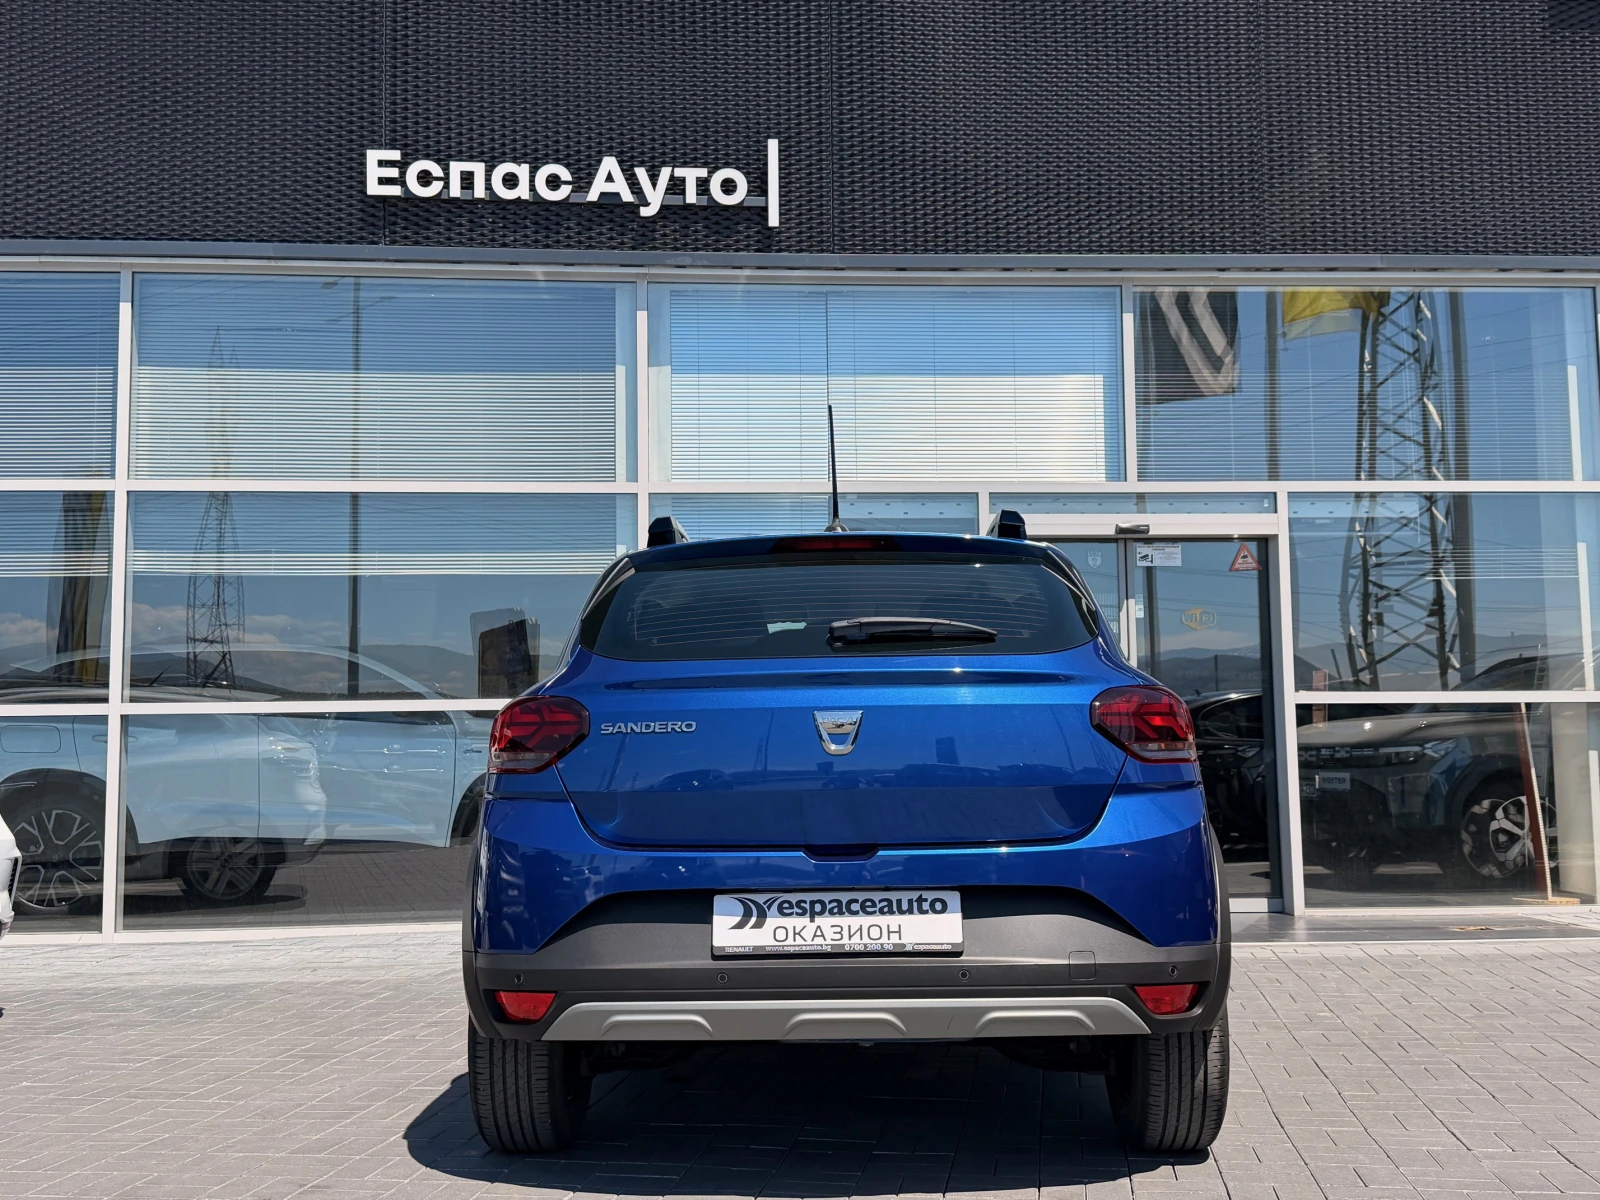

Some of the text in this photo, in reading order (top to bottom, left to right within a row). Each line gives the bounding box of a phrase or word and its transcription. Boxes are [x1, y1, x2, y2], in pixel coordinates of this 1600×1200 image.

[366, 149, 748, 217] Еспас Ауто
[600, 720, 697, 734] SANDERO
[776, 893, 949, 923] espaceauto
[772, 924, 902, 943] ОКАЗИОН
[765, 944, 832, 952] www.espaceauto.bg
[844, 943, 894, 951] 0700 200 90
